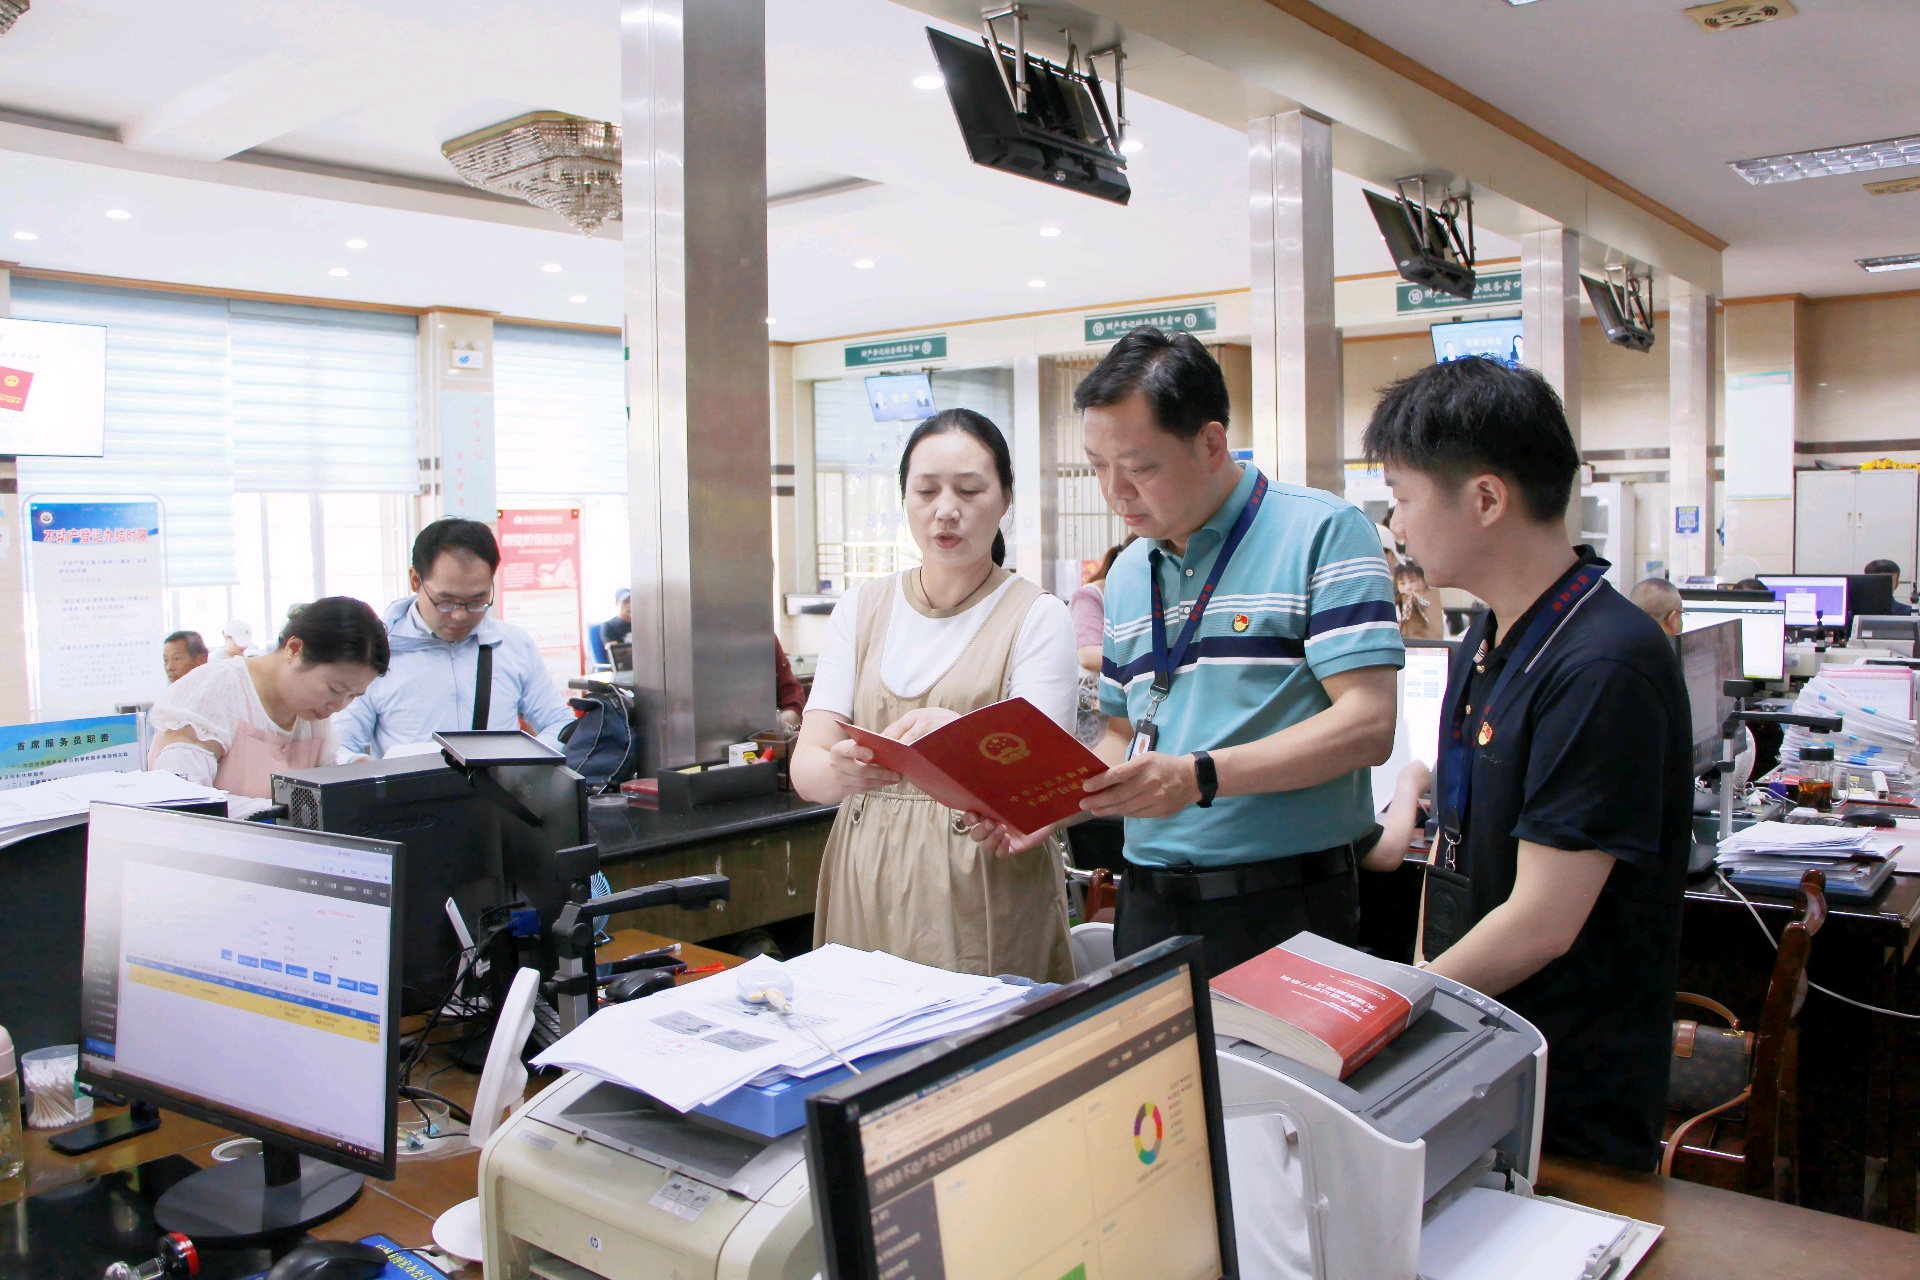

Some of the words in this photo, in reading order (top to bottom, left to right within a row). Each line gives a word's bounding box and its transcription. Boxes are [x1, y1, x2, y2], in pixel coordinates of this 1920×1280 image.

[1424, 279, 1521, 298] 财产合服务窗口
[44, 528, 148, 544] 不动产登记办结时限
[16, 733, 110, 751] 首席服务员职责
[1010, 766, 1089, 802] 中华人民共和国
